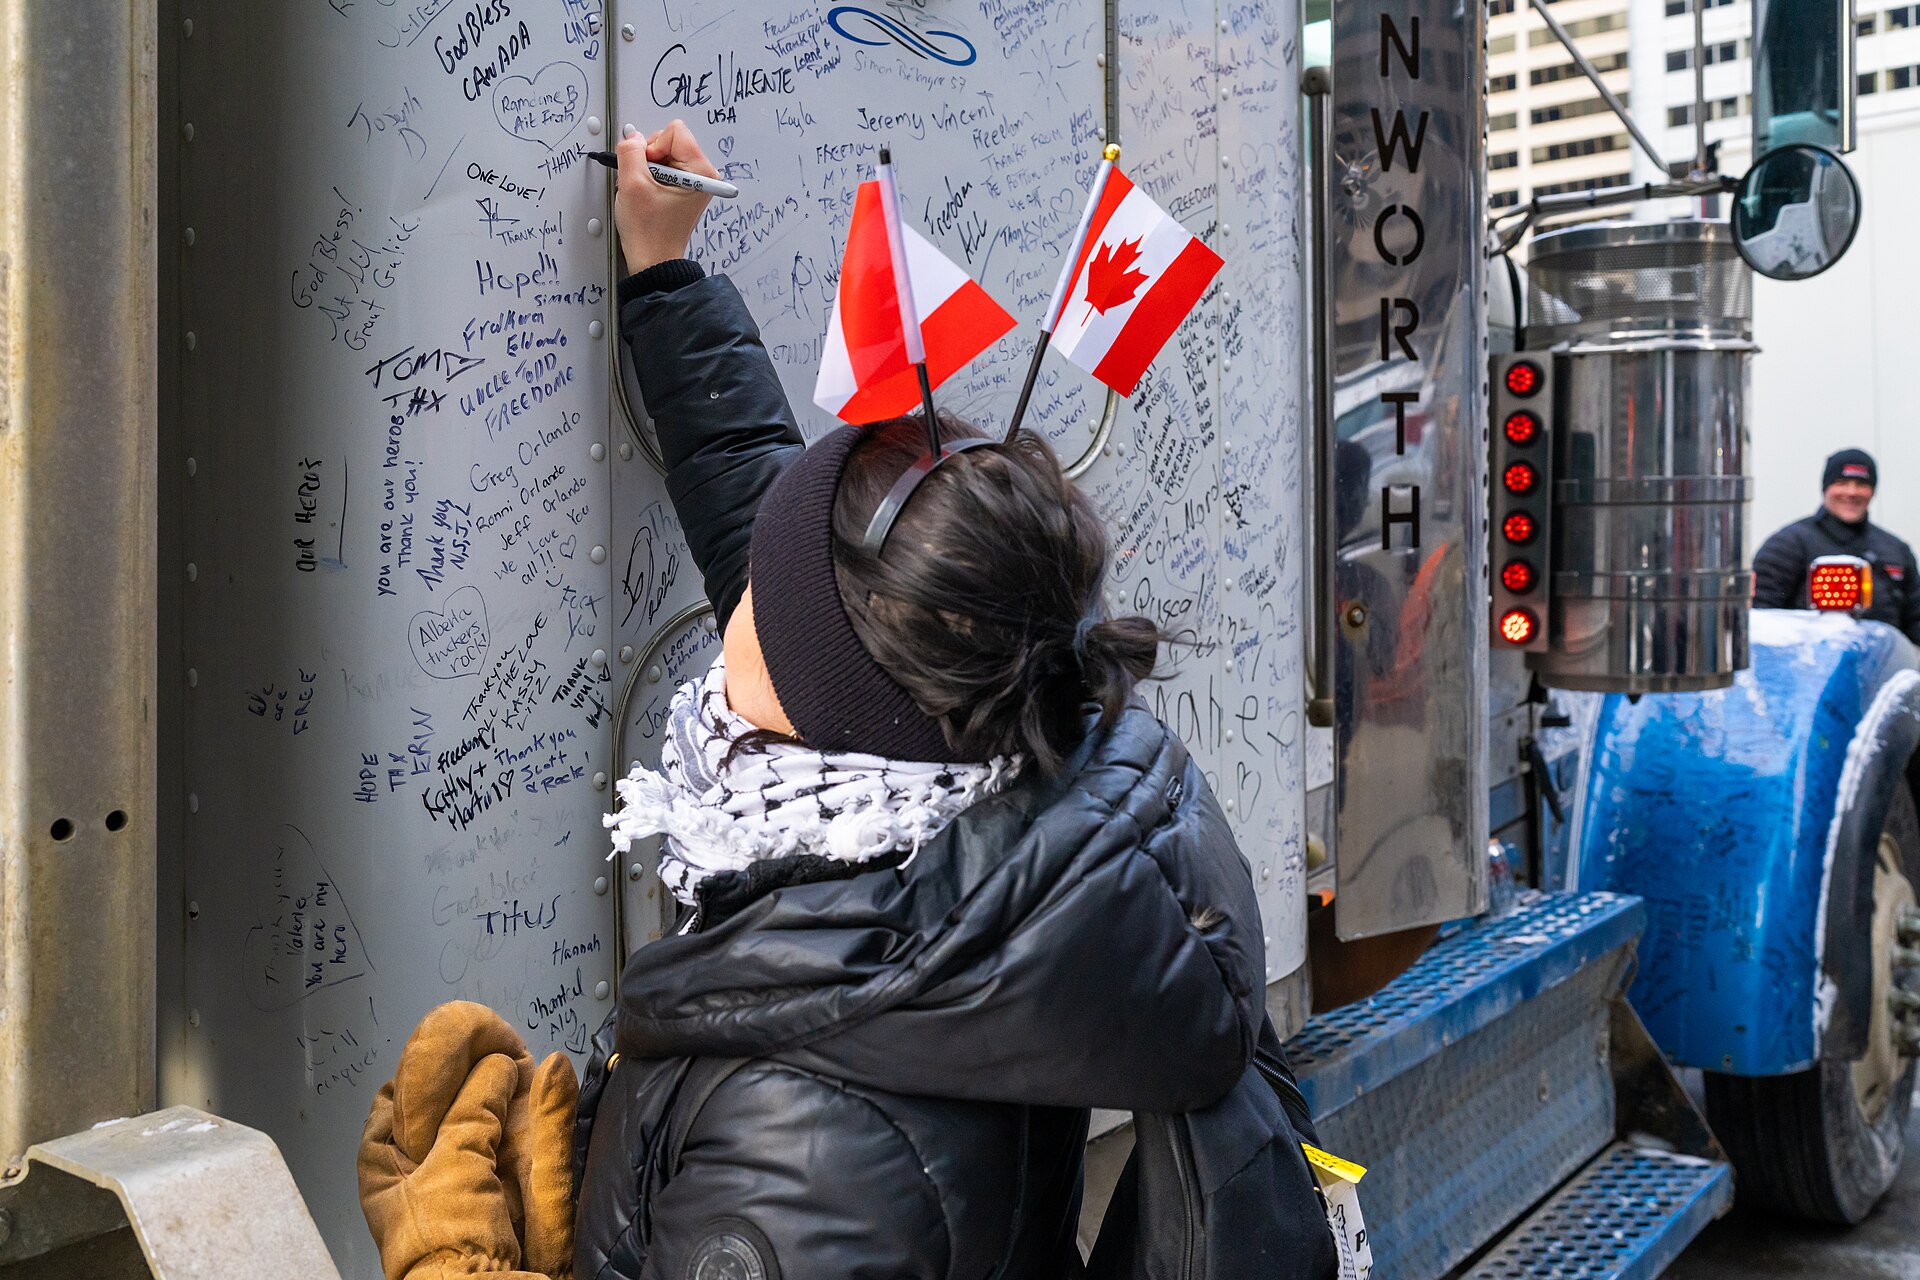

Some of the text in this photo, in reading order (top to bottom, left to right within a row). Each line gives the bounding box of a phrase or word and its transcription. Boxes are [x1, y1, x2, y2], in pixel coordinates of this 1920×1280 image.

[463, 20, 531, 101] CANADA
[707, 105, 737, 125] USA
[856, 107, 927, 141] Jeremy
[466, 162, 546, 208] ONE LOVE!
[470, 410, 582, 493] Greg Orlando
[383, 479, 395, 511] our
[520, 465, 567, 506] Orlando
[500, 477, 588, 551] Jeff Orlando
[380, 519, 394, 554] are
[398, 512, 415, 569] Thank
[378, 564, 397, 597] you
[418, 607, 473, 648] Alberta
[551, 656, 589, 704] THANK
[552, 933, 601, 966] Hannah
